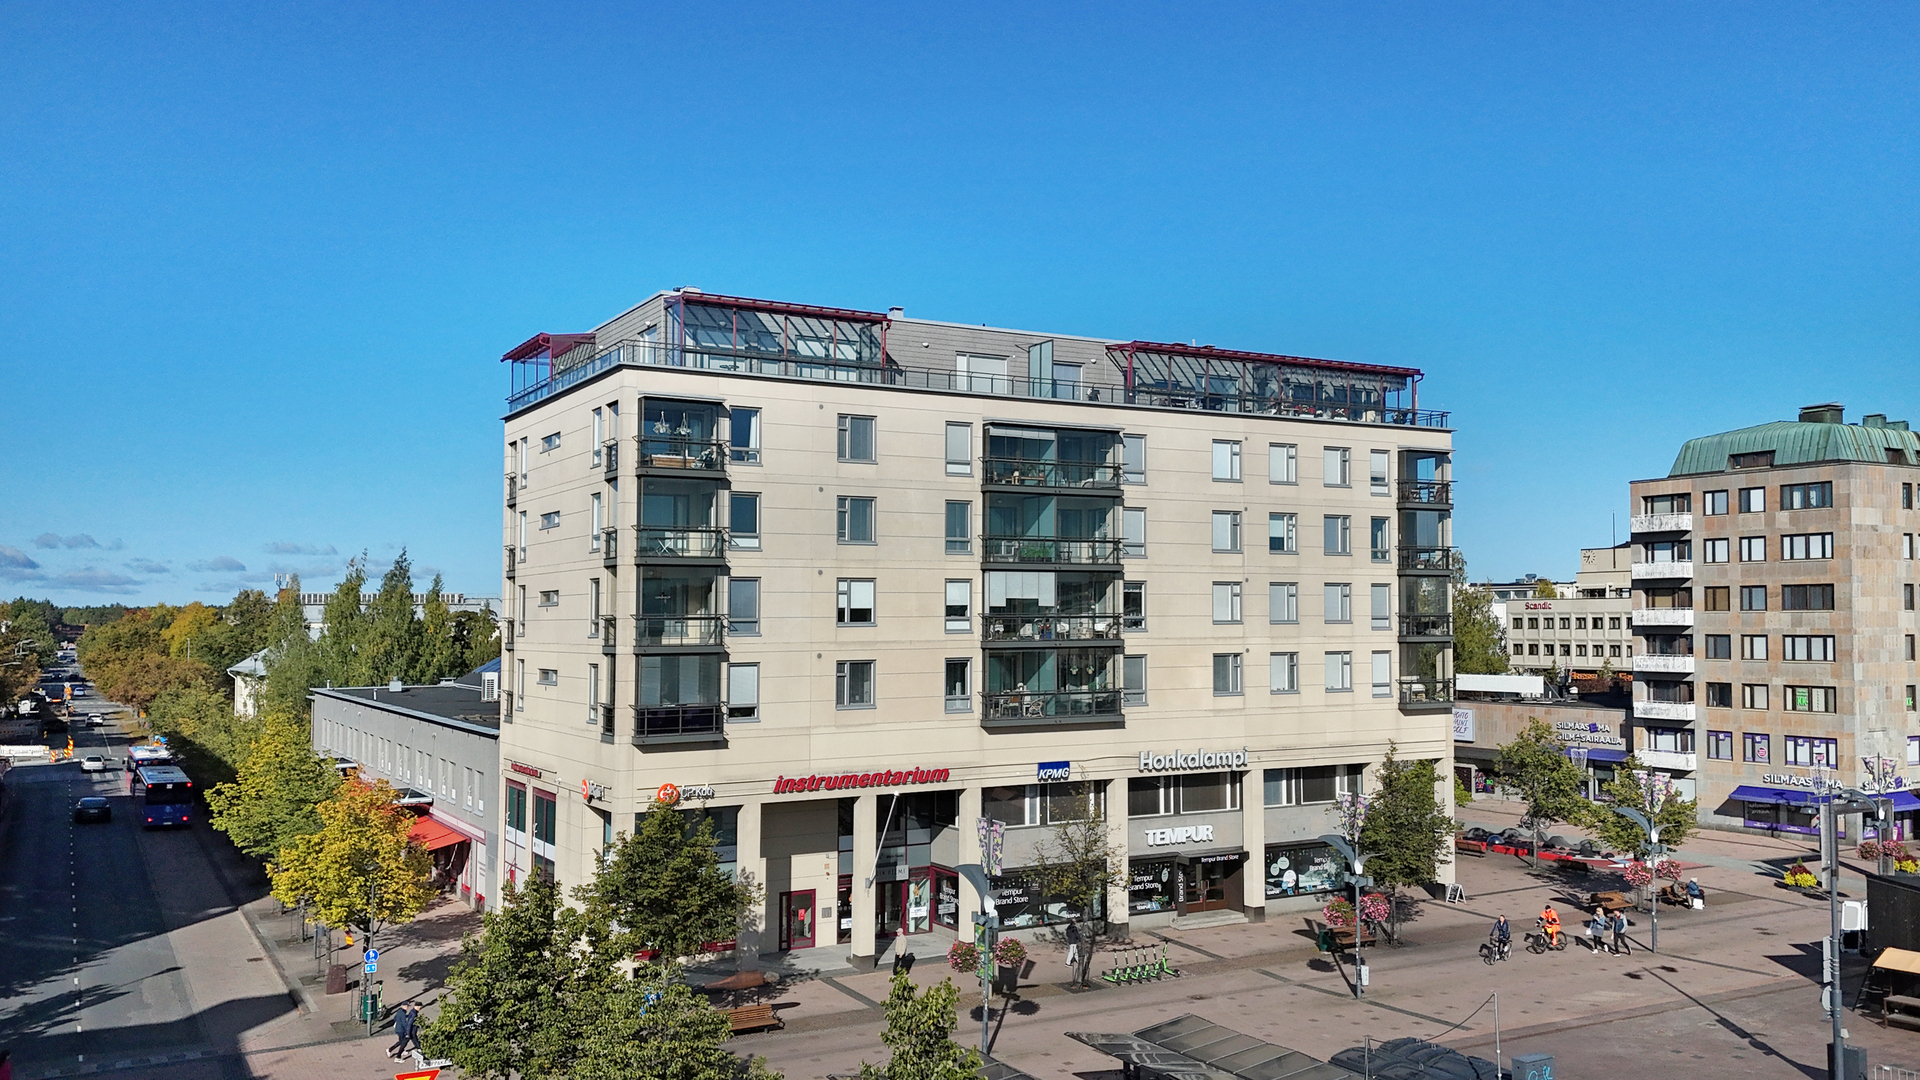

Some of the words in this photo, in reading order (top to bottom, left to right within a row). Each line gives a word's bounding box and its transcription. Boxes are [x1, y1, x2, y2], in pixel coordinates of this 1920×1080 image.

[1525, 602, 1552, 610] Scandic
[1138, 746, 1249, 772] Honkalampi
[773, 766, 950, 794] instrumentarium
[1038, 767, 1070, 781] KPMG
[1763, 773, 1844, 790] SILMÄASMA
[1145, 824, 1214, 847] TEMPUR
[1134, 874, 1153, 883] Tempur
[1145, 881, 1159, 890] Store
[1001, 887, 1024, 897] Tempur
[995, 897, 1013, 905] Brand
[1013, 896, 1029, 904] Store
